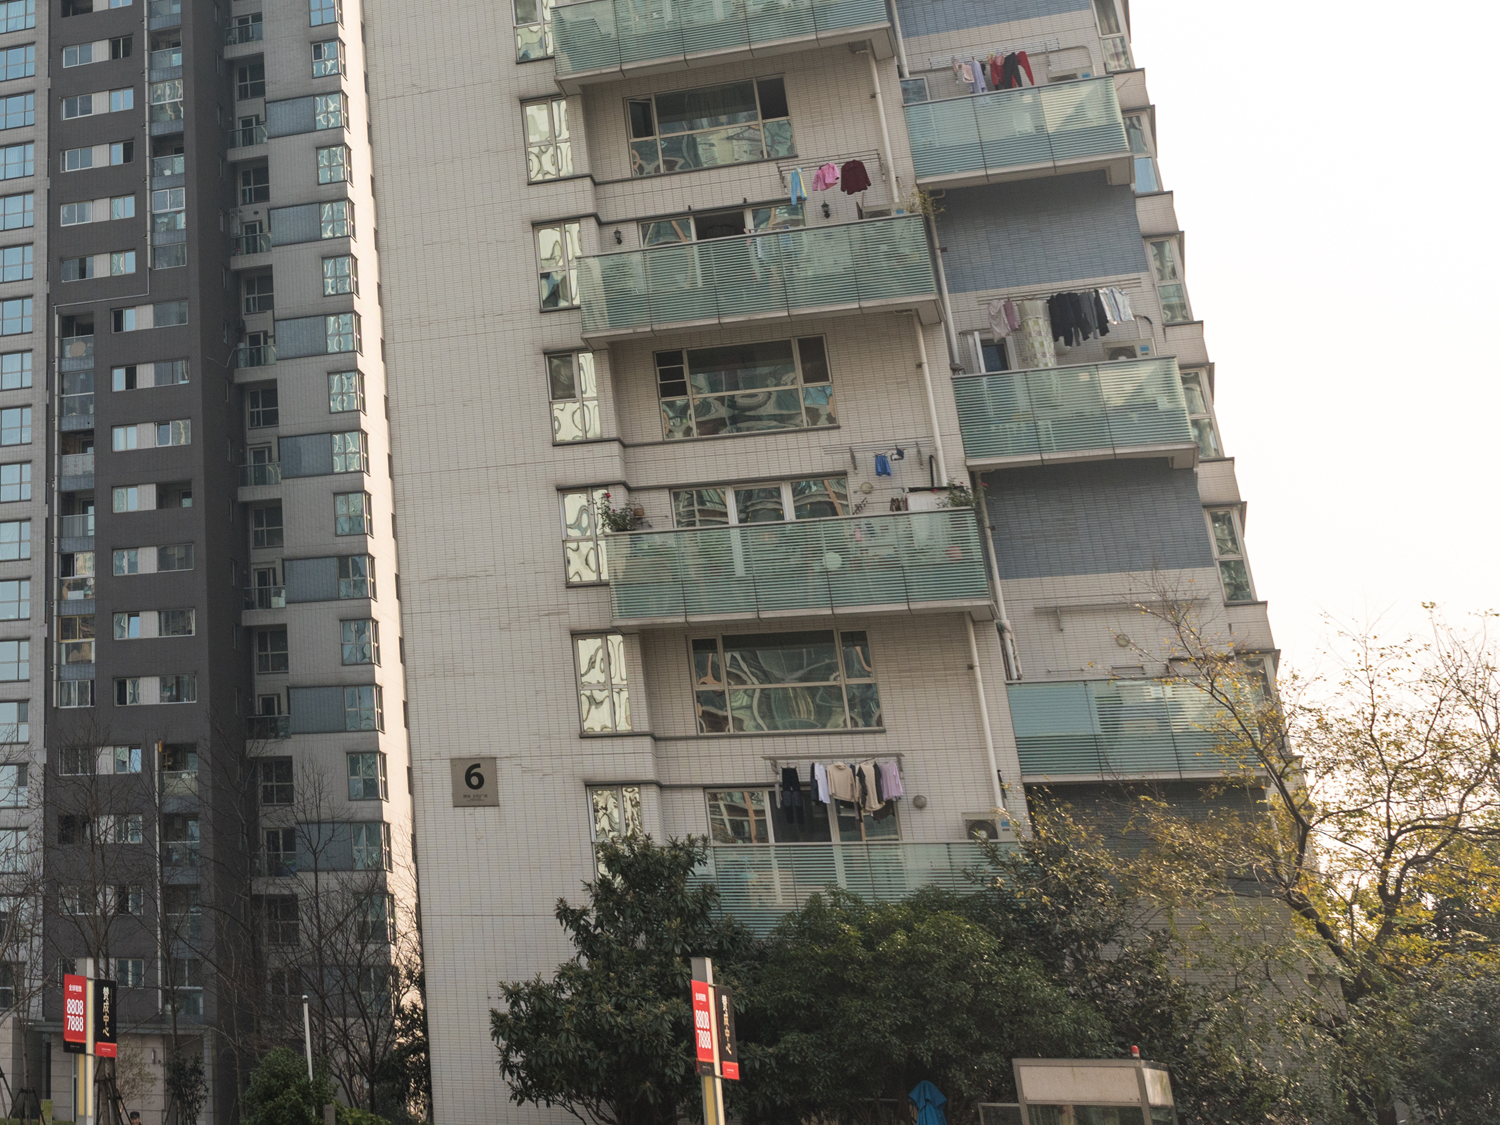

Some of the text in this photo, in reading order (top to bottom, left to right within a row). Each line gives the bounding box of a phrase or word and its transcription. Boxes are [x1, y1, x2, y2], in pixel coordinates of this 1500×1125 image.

[465, 763, 485, 790] 6
[66, 998, 84, 1015] 8808
[66, 1015, 84, 1032] 7888
[695, 1010, 709, 1029] 8808
[697, 1030, 711, 1049] 7888
